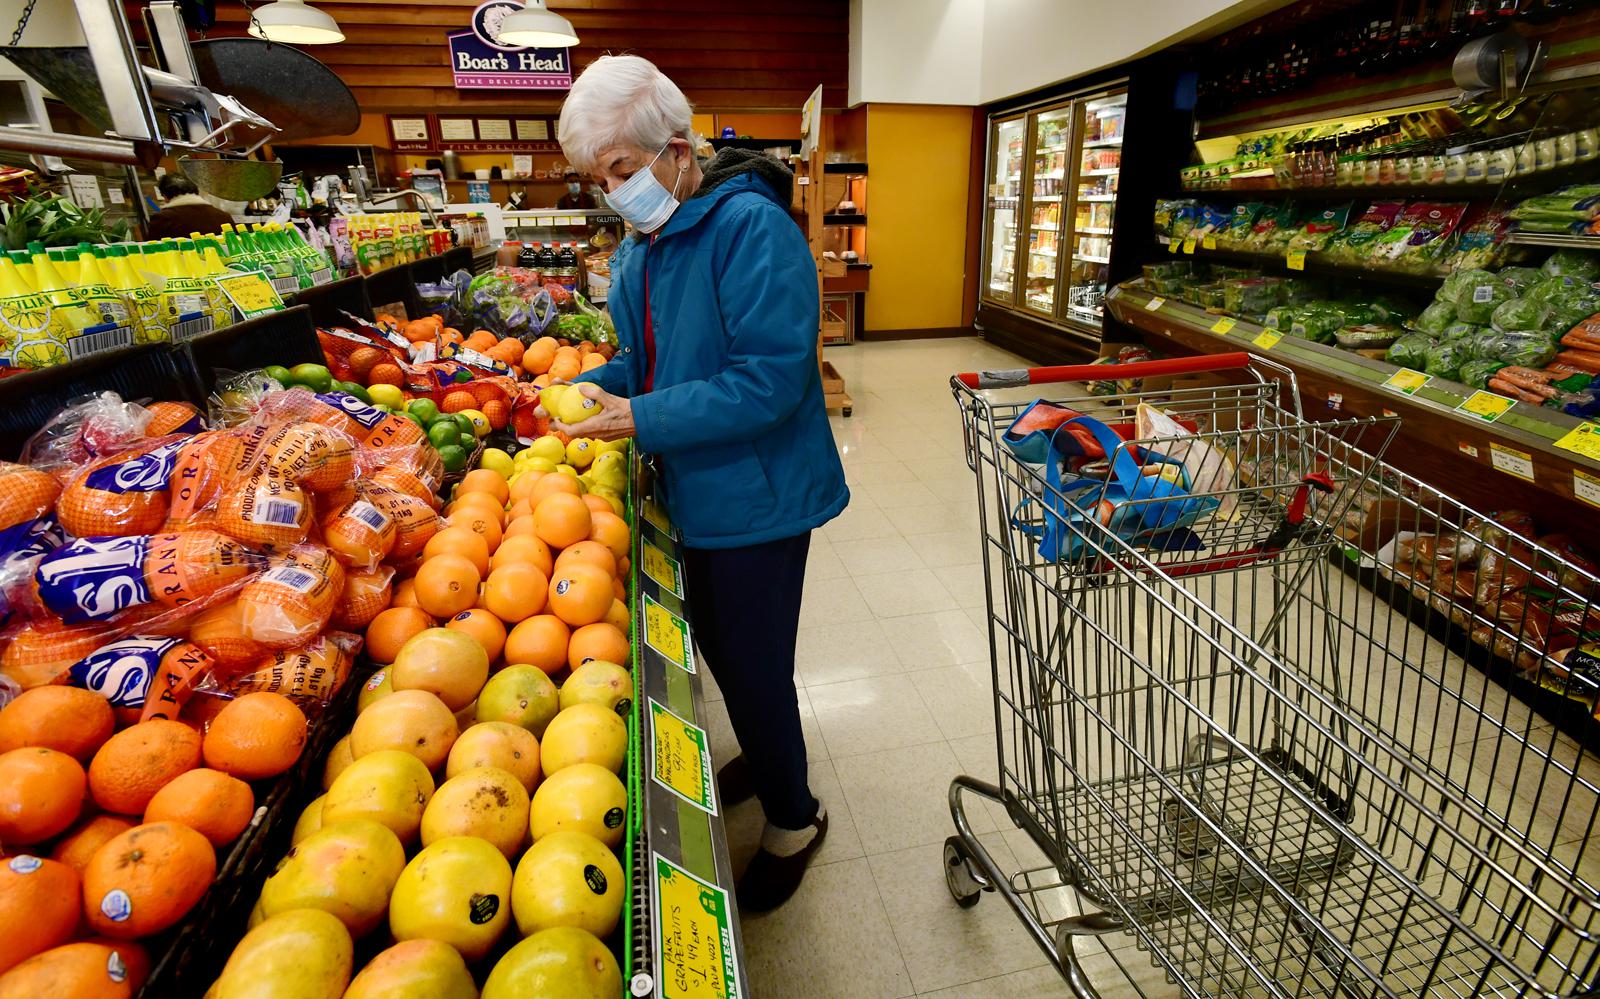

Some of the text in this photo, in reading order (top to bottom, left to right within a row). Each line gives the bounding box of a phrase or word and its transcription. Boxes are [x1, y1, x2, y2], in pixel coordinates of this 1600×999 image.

[457, 51, 564, 71] Boar's Head
[236, 424, 269, 472] Sunkist
[671, 905, 688, 992] GRAPEFRUITS
[690, 920, 700, 944] EACH
[721, 926, 735, 978] FRESH
